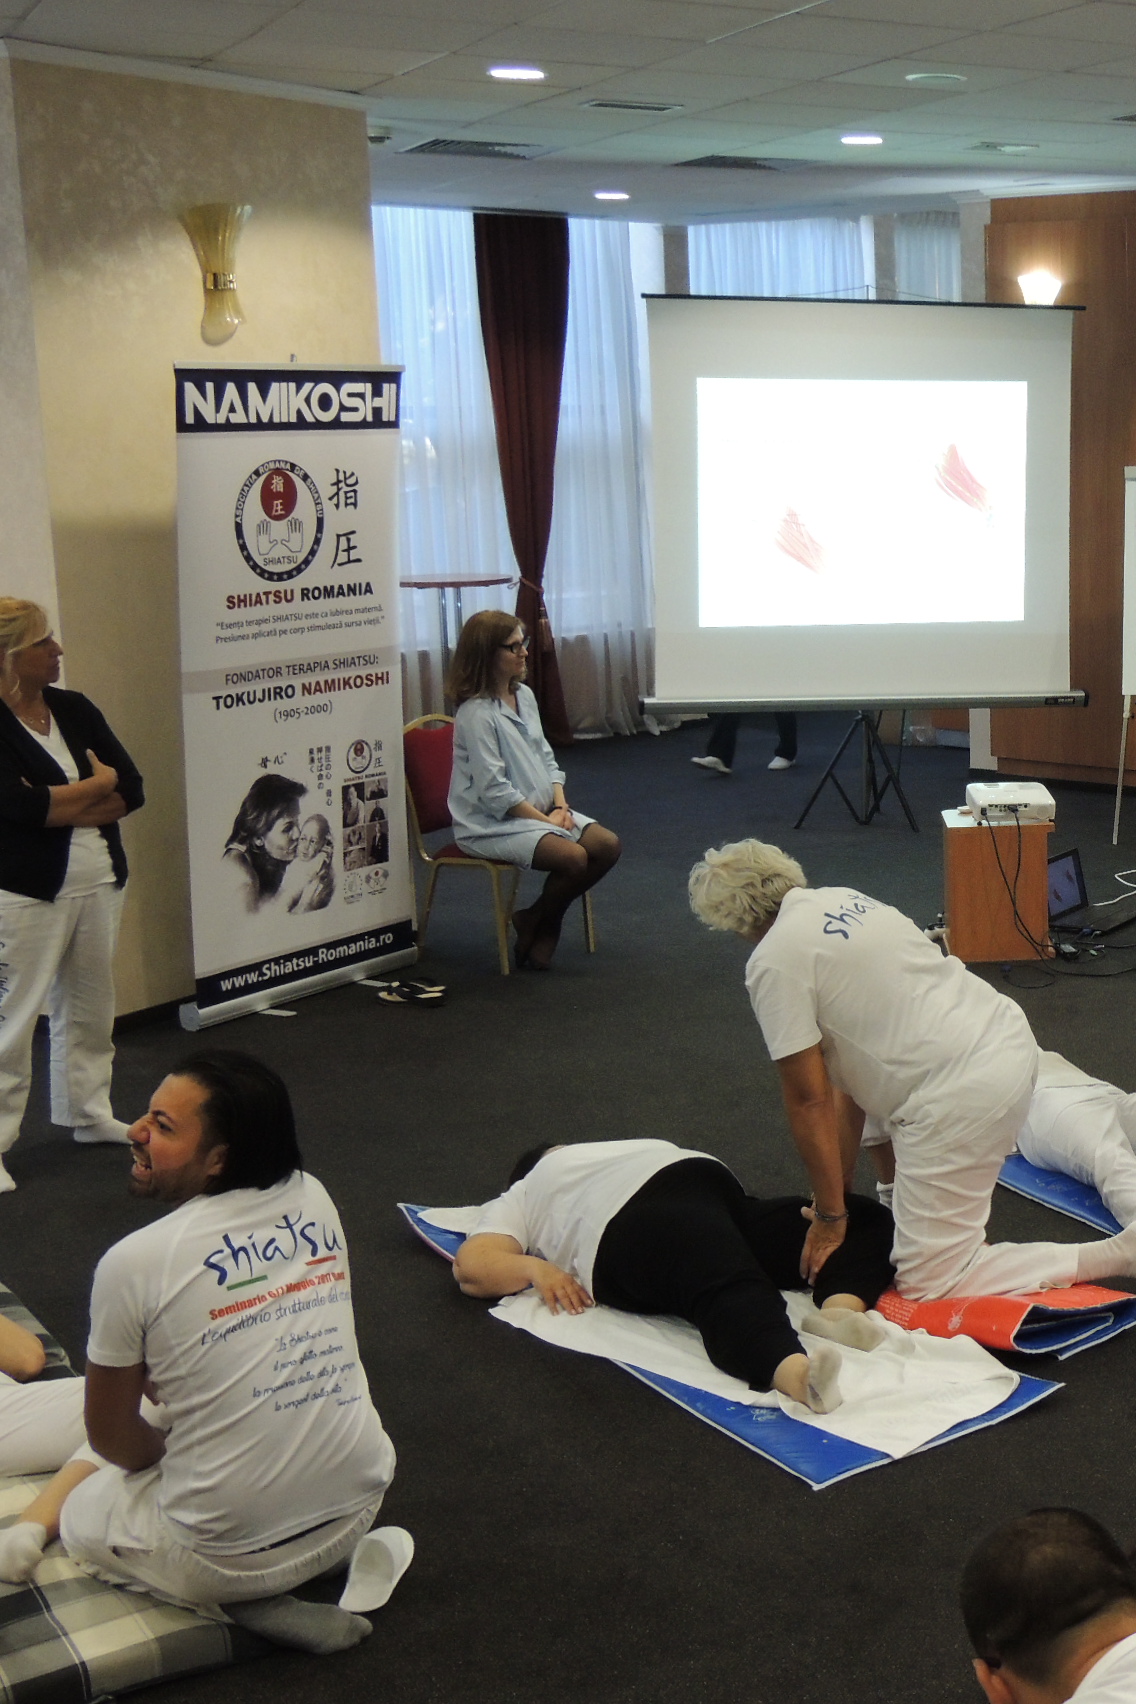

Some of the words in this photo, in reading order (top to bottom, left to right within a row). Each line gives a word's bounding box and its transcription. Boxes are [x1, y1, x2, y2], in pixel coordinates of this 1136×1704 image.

[183, 381, 397, 424] NAMIKOSHI
[263, 555, 298, 567] SHIATSU
[225, 588, 295, 610] SHIATSU
[300, 581, 374, 602] ROMANIA
[272, 612, 303, 624] SHIATSU
[278, 628, 288, 638] pe
[225, 665, 283, 686] FONDATOR
[285, 660, 330, 677] TERAPIA
[332, 654, 379, 671] SHIATSU:
[212, 684, 296, 711] TOKUJIRO
[301, 670, 390, 697] NAMIKOSHI
[273, 700, 333, 724] (1905-2000)
[220, 931, 394, 992] www.Shiatsu-Romania.ro
[209, 1294, 268, 1321] Seminario
